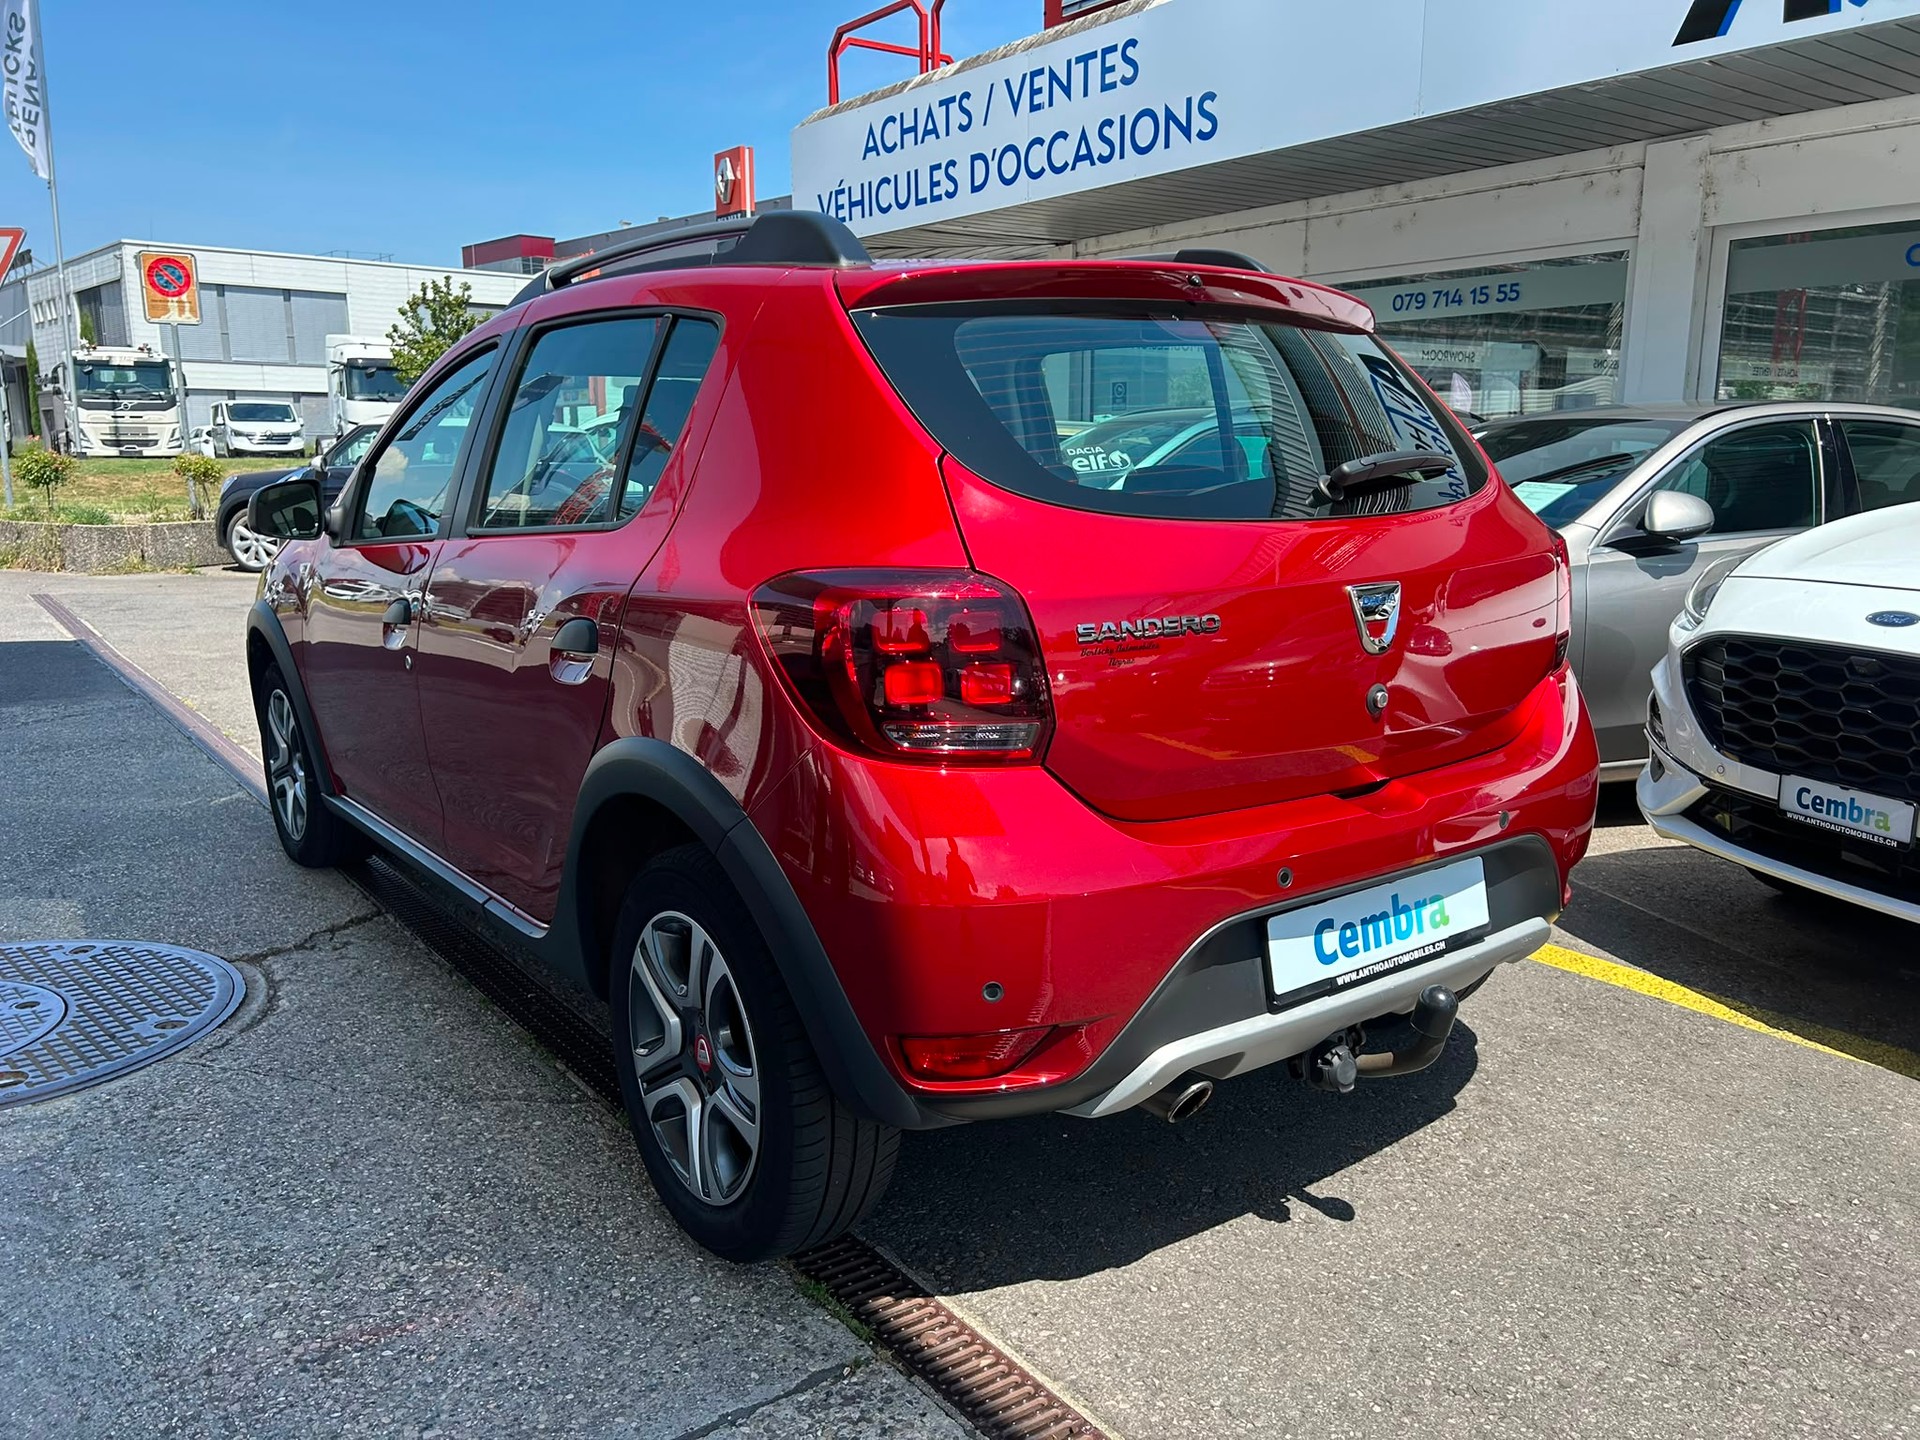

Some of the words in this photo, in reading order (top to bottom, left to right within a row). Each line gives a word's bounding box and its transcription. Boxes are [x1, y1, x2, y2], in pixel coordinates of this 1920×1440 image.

[861, 90, 973, 161] ACHATS
[982, 82, 995, 127] /
[1004, 37, 1140, 117] VENTES
[816, 158, 959, 224] VÉHICULES
[970, 90, 1219, 194] D'OCCASIONS
[1392, 292, 1426, 312] 079
[1432, 289, 1463, 309] 714
[1470, 285, 1490, 305] 15
[1496, 282, 1521, 302] 55
[1066, 446, 1105, 456] DACIA
[1072, 453, 1109, 471] elf
[1076, 613, 1221, 645] SANDERO
[1786, 811, 1898, 848] WWW.ANTHOAUTOMOBILES.CH
[1796, 786, 1891, 832] Cembra
[1313, 892, 1450, 966] Cembra
[1336, 940, 1446, 986] WWW.ANTHOAUTOMOBILES.CH
